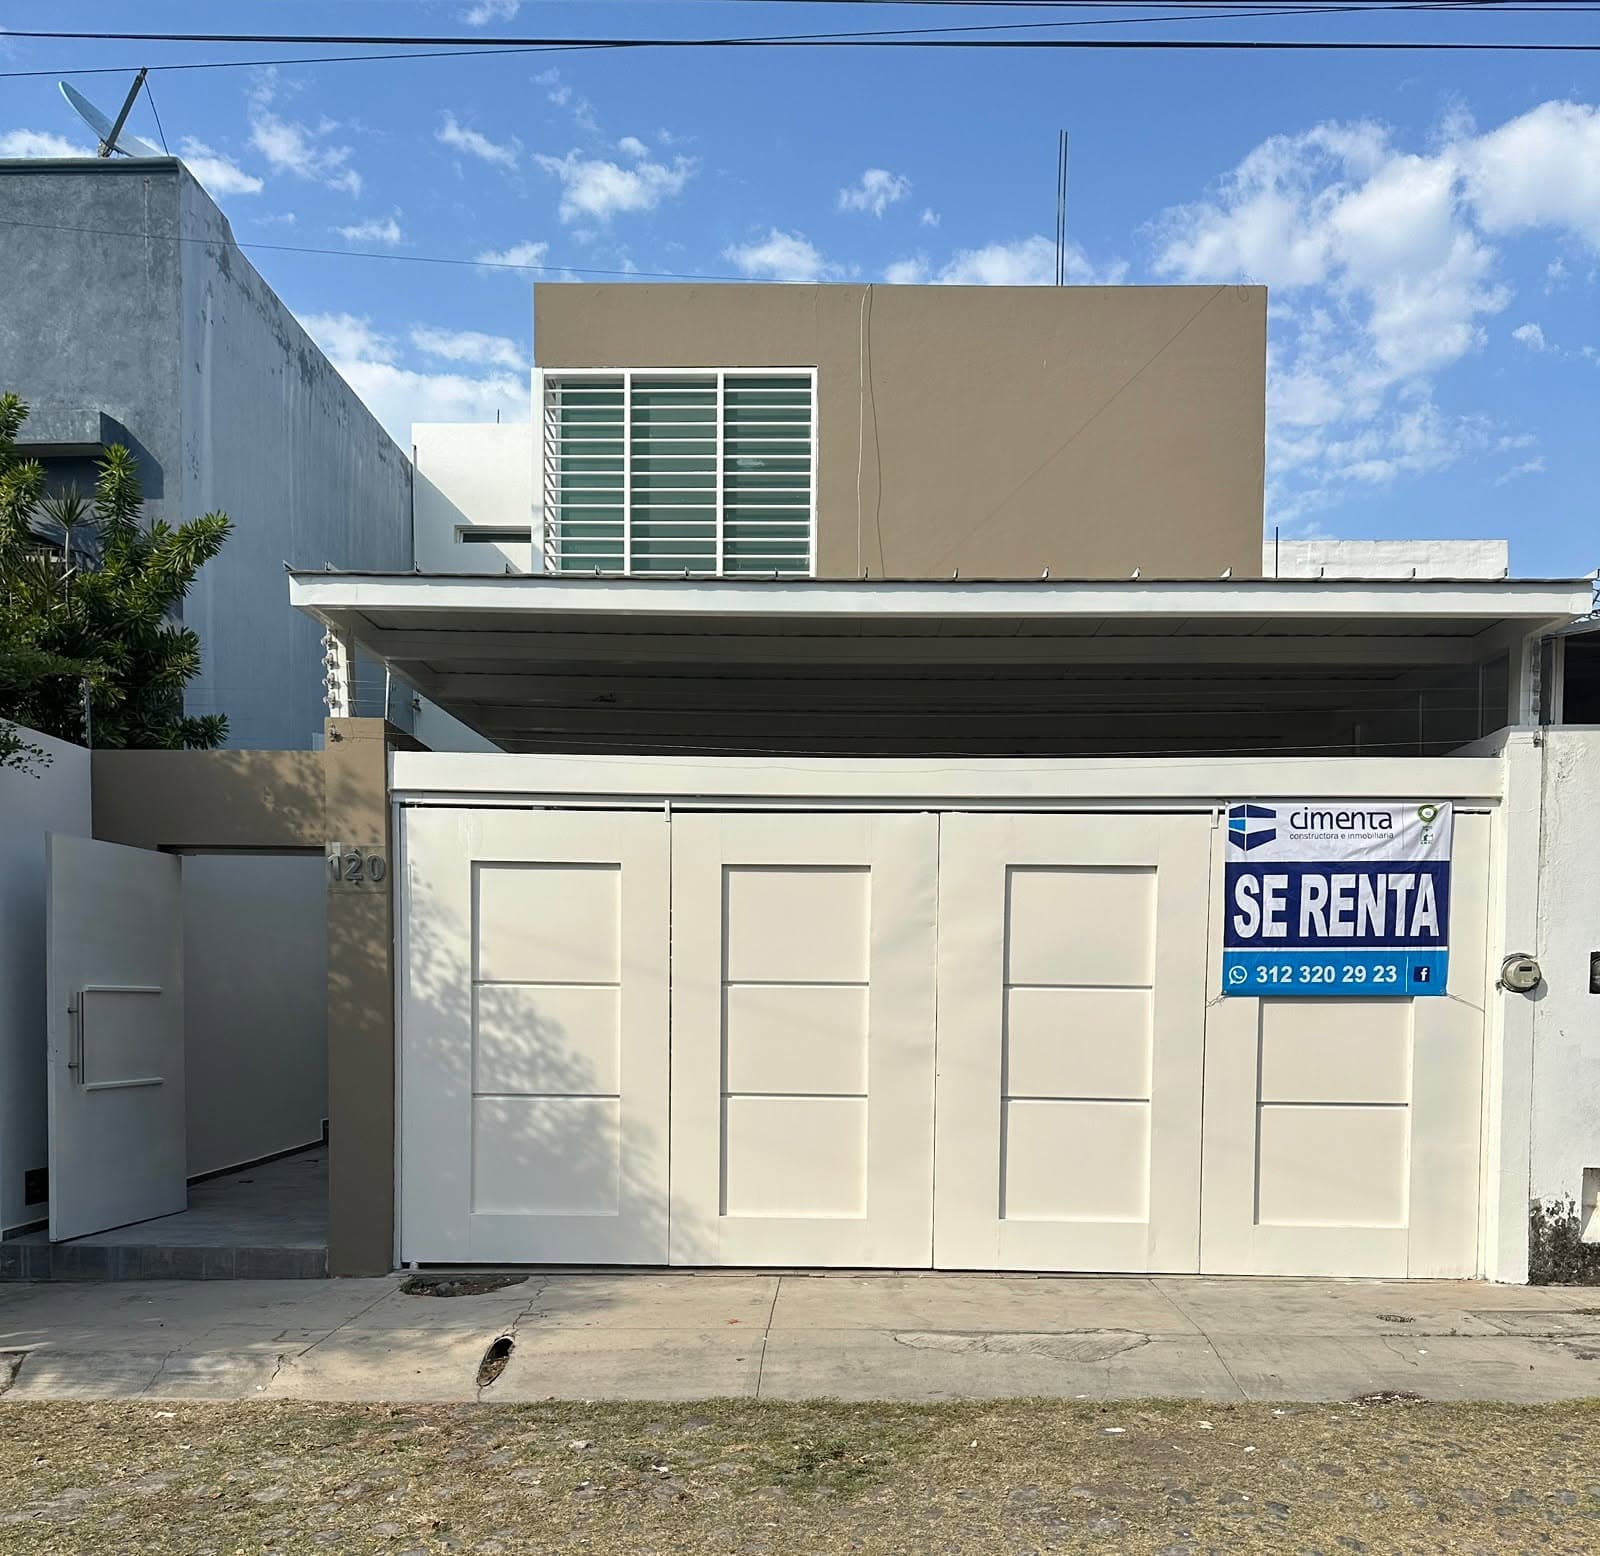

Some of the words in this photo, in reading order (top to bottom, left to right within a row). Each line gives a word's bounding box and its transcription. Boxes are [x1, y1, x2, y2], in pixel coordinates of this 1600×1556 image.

[1290, 806, 1393, 830] cimenta
[1289, 832, 1339, 840] constructora
[1347, 832, 1394, 840] inmobiliaria
[328, 853, 386, 881] 120
[1233, 873, 1289, 938] SE
[1299, 873, 1440, 937] RENTA
[1256, 965, 1292, 983] 312
[1299, 965, 1336, 983] 320
[1342, 965, 1367, 983] 29
[1372, 965, 1397, 983] 23
